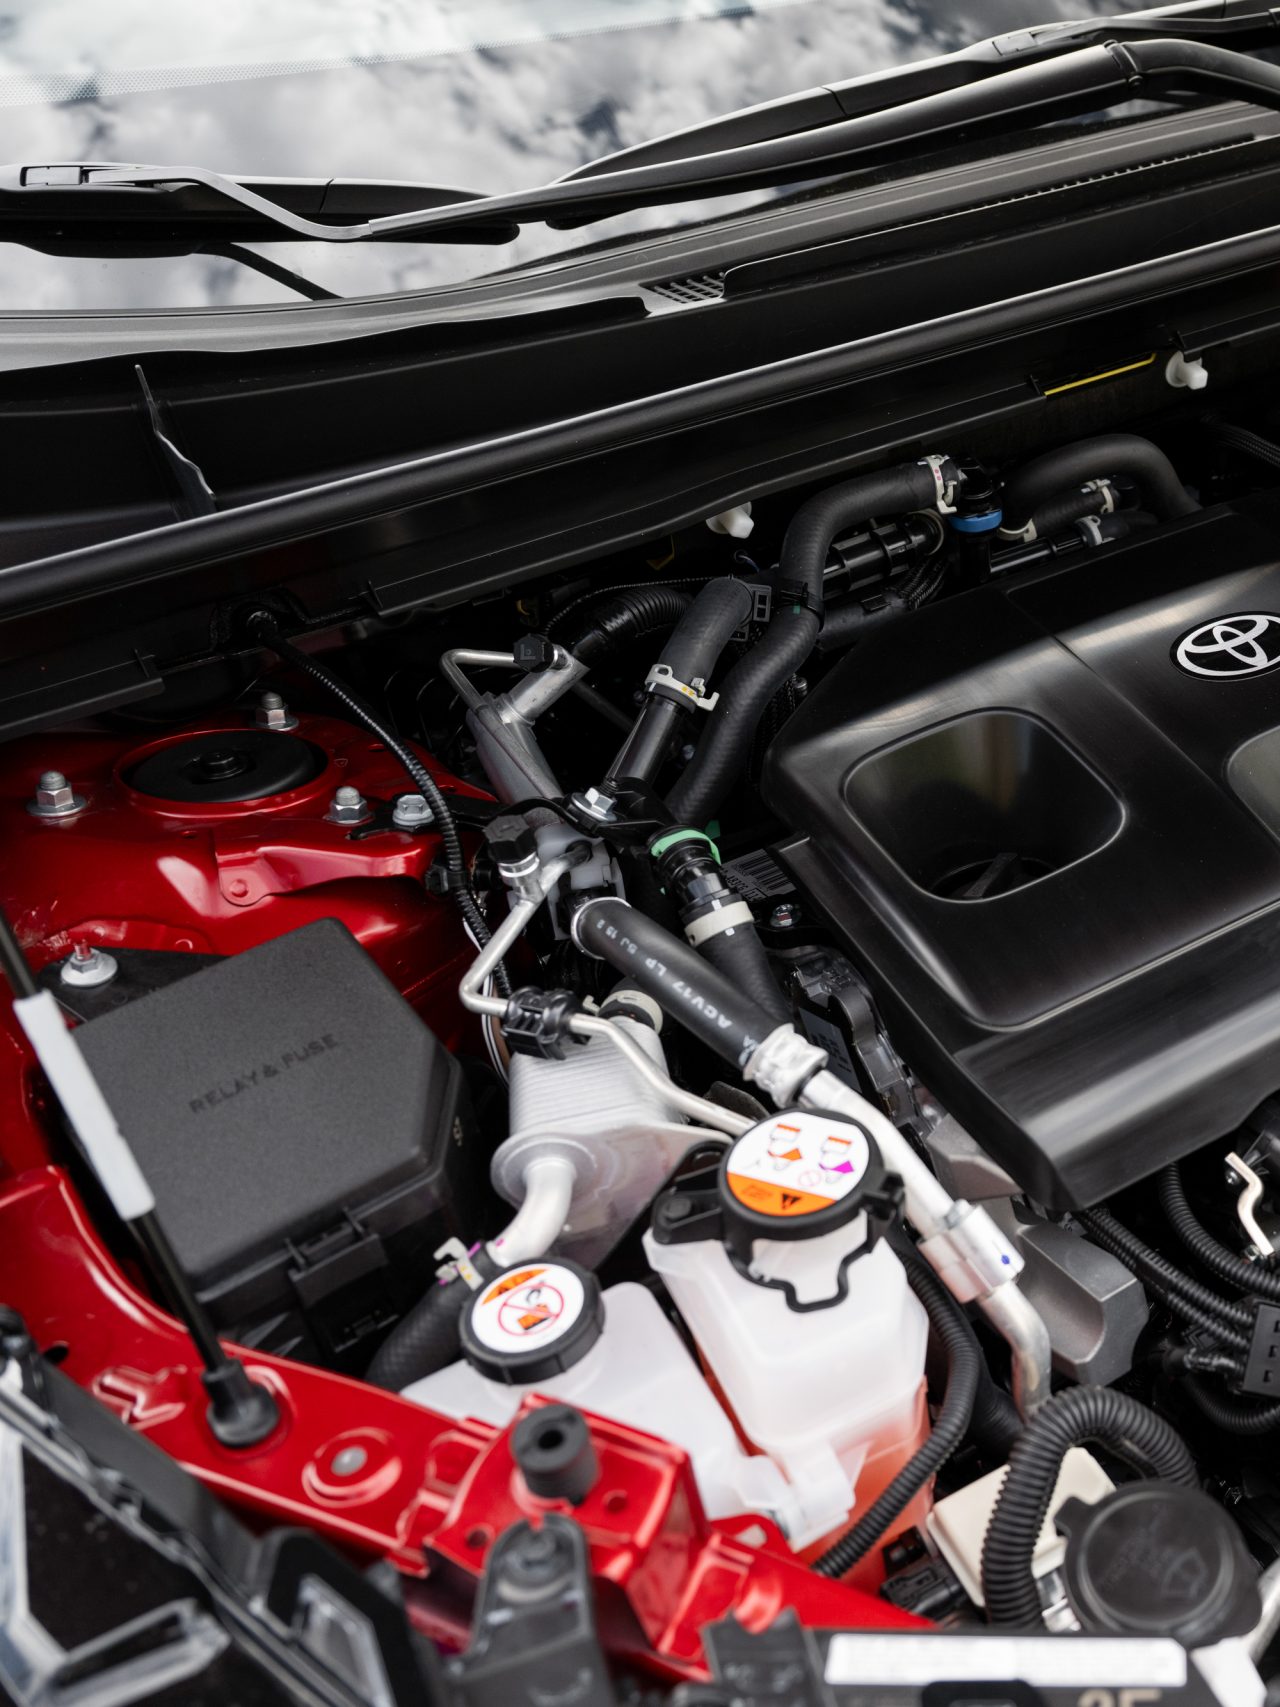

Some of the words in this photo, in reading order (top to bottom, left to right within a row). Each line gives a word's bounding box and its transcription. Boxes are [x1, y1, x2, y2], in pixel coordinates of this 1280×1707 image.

[644, 957, 668, 977] LP
[671, 980, 734, 1030] ACV17
[188, 1069, 258, 1114] RELAY
[281, 1032, 339, 1070] FUSE
